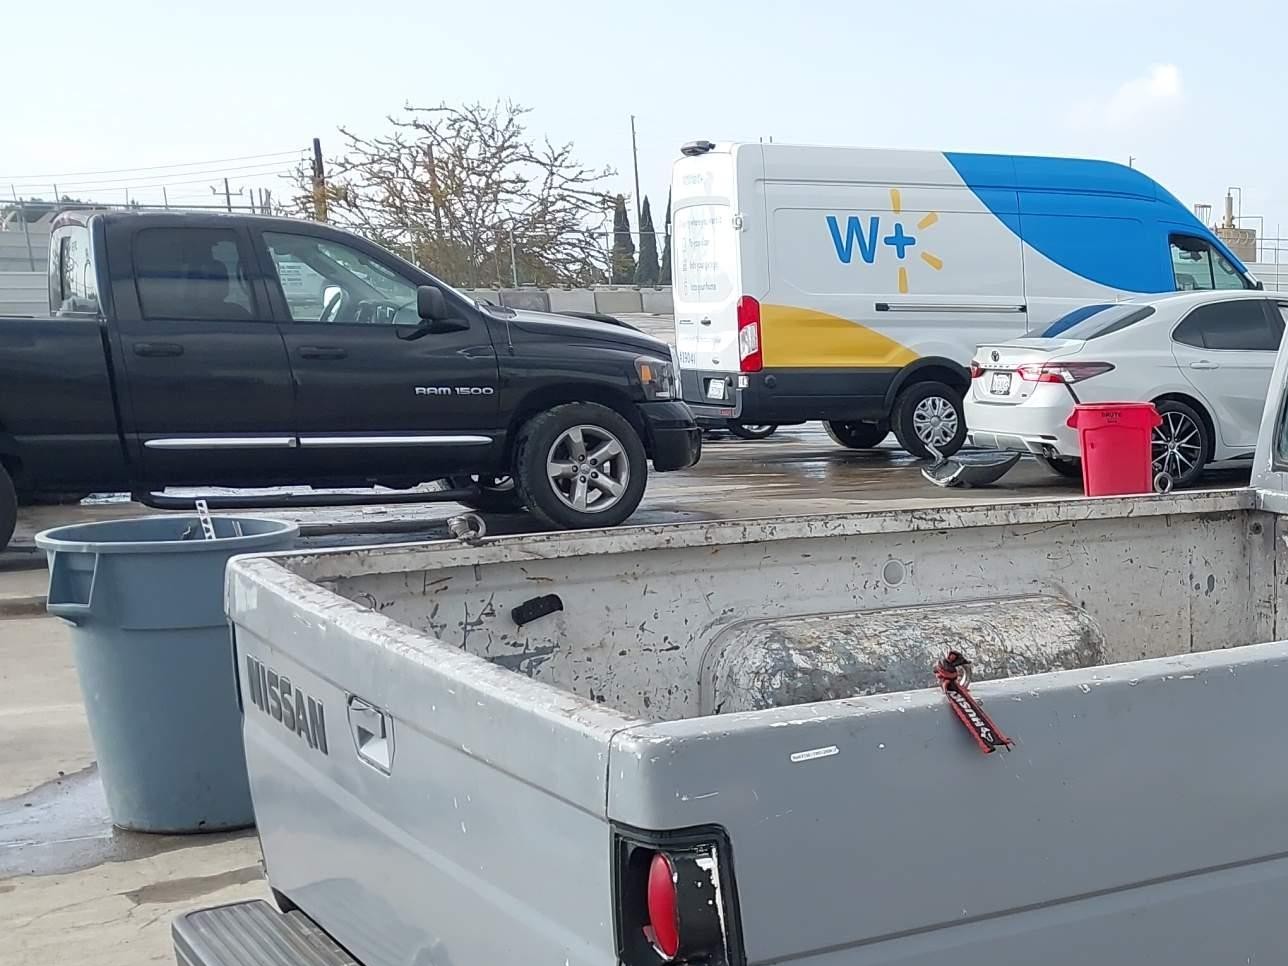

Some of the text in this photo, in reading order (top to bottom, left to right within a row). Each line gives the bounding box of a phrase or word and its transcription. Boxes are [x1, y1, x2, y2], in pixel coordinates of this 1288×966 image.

[415, 387, 494, 395] RAM 1500
[246, 654, 328, 756] NISSAN
